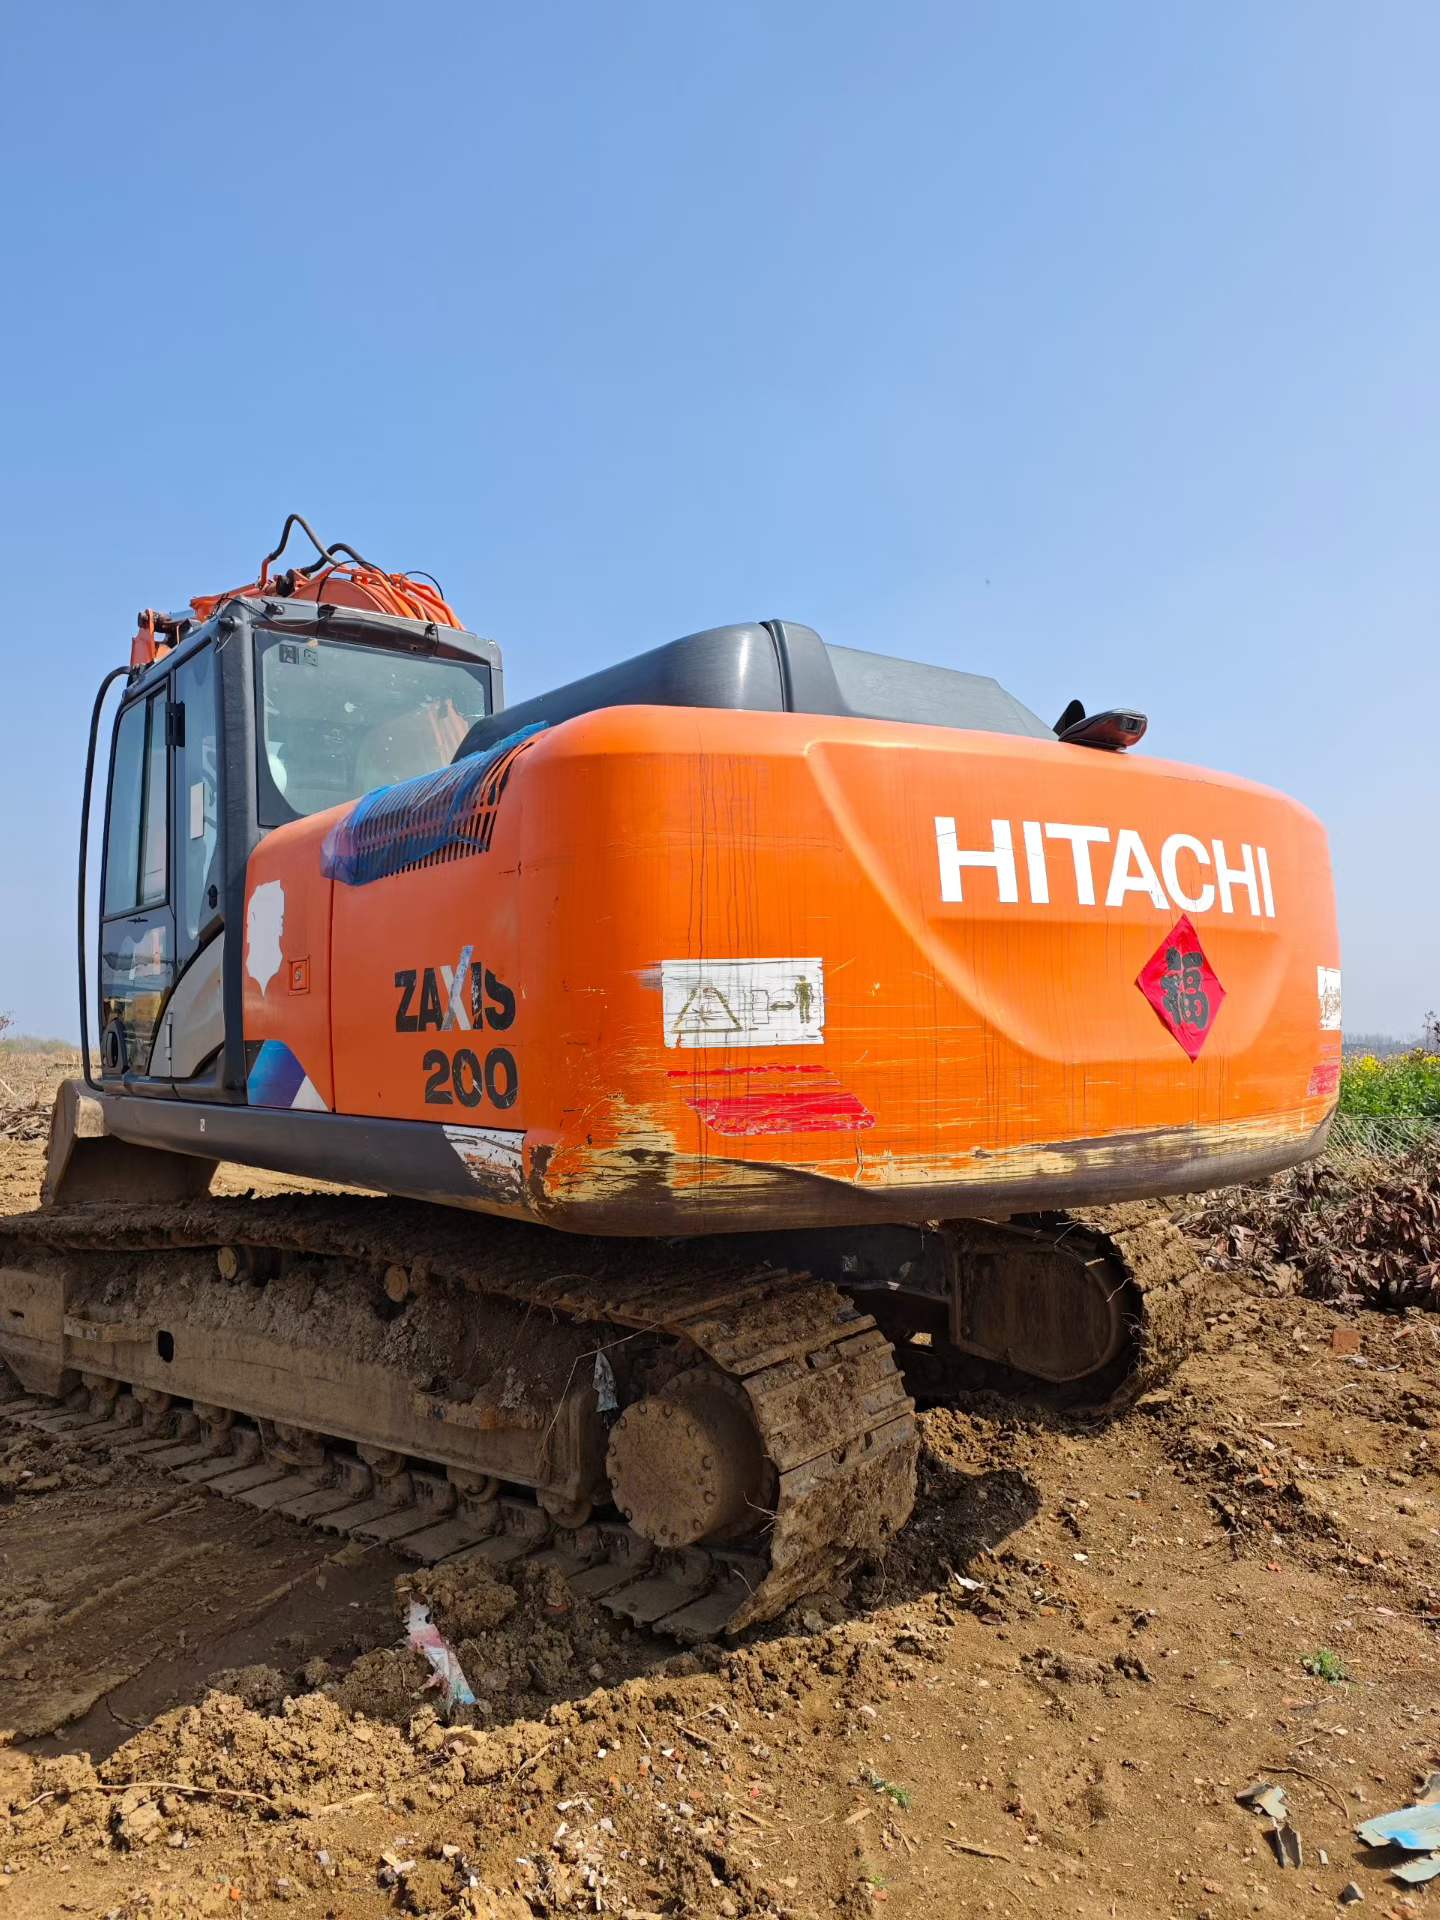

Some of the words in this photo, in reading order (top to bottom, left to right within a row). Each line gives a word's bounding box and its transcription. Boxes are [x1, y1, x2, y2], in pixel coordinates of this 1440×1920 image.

[934, 816, 1276, 918] HITACHI
[394, 944, 516, 1032] ZAXIS
[1160, 946, 1210, 1031] 福
[422, 1047, 518, 1109] 200
